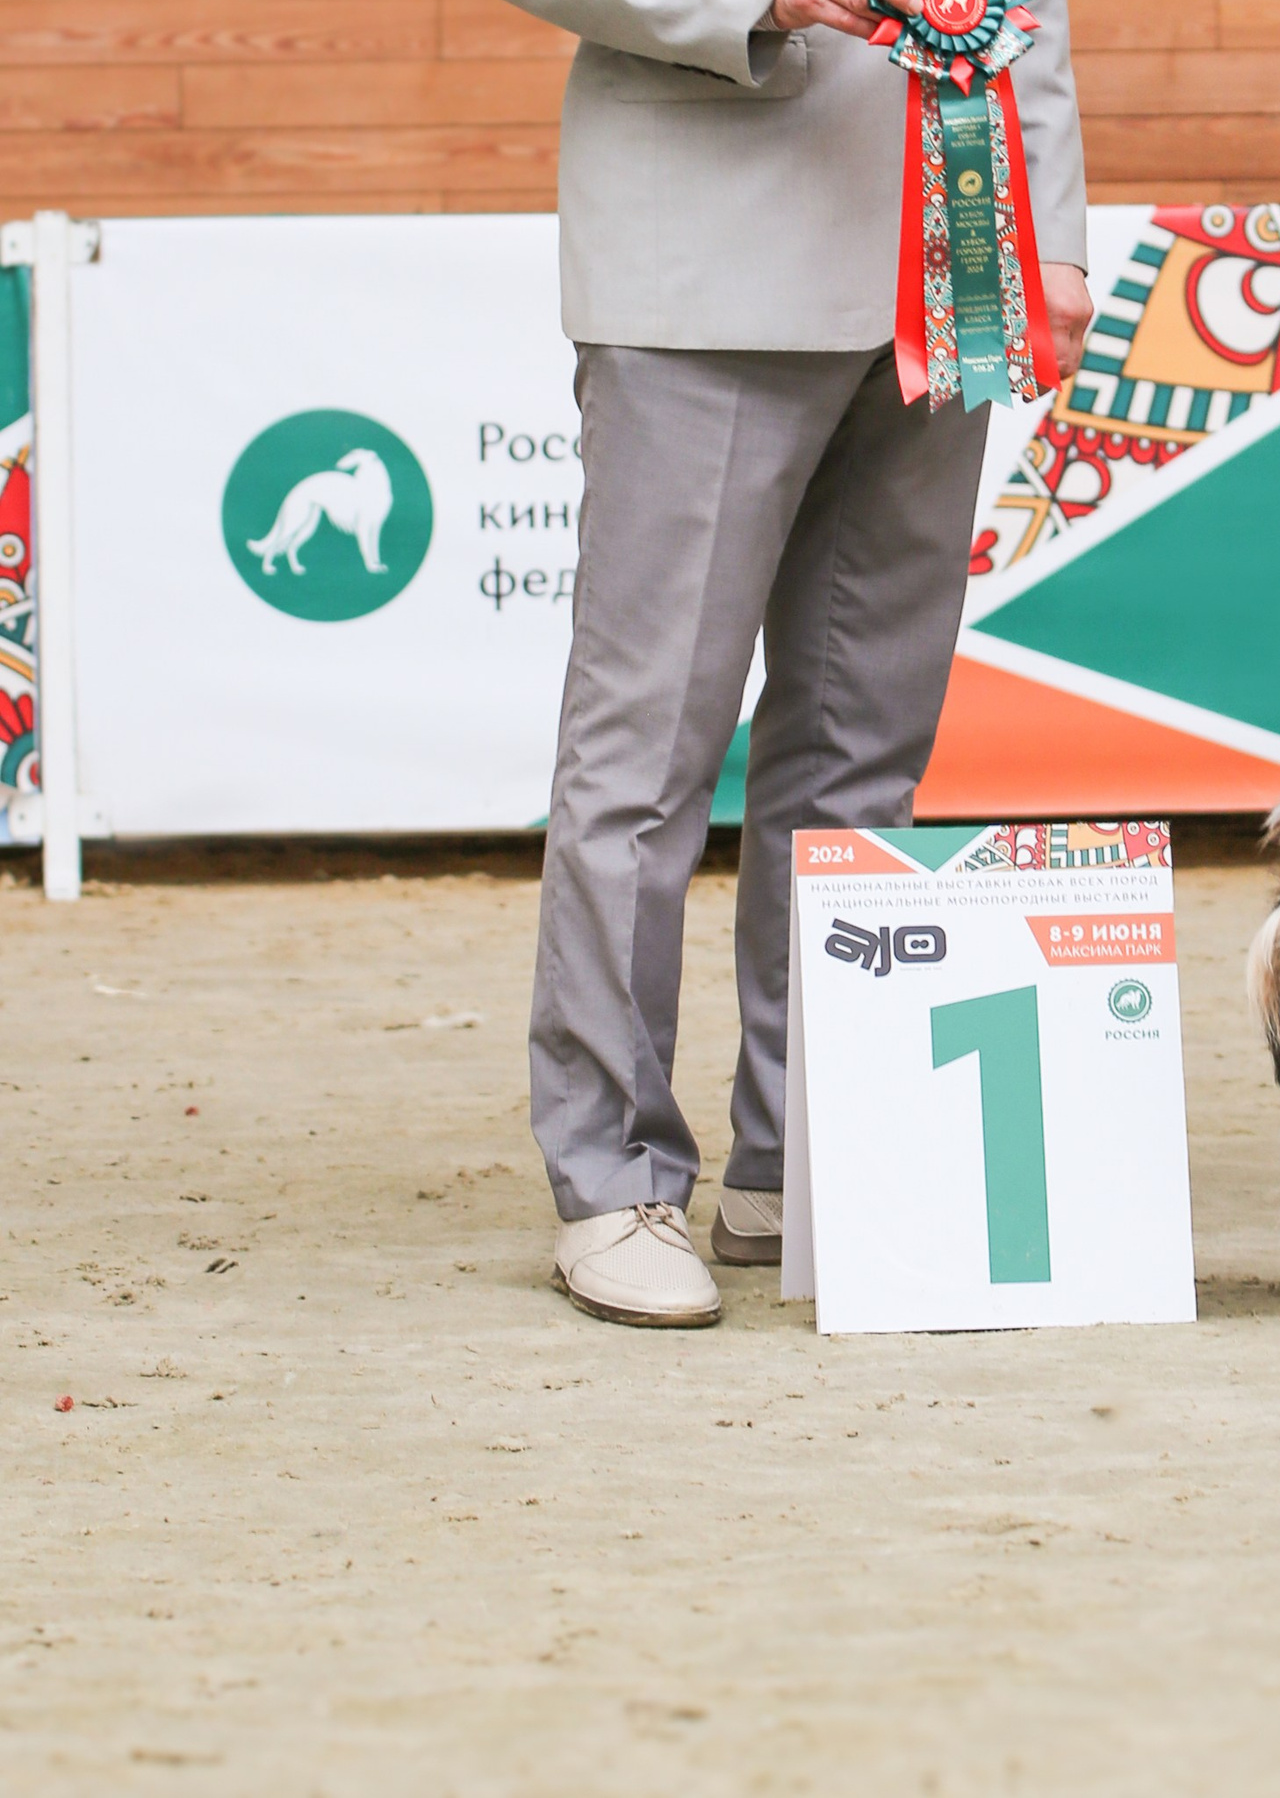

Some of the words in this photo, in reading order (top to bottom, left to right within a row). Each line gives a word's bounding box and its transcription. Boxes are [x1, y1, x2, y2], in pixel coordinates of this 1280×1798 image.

[480, 501, 580, 530] кин
[808, 845, 855, 864] 2024
[811, 880, 931, 894] НАЦИОНАЛЬНЫЕ
[936, 876, 1012, 890] ВЫСТАВКИ
[1017, 876, 1065, 889] СОБАК
[1070, 875, 1104, 887] ВСЕХ
[1110, 874, 1159, 886] ПОРОД
[822, 897, 942, 910] НАЦИОНАЛЬНЫЕ
[947, 893, 1068, 907] МОНОПОРОДНЫЕ
[1074, 891, 1149, 904] ВЫСТАВКИ
[1049, 924, 1085, 943] 8-9
[1091, 922, 1162, 942] ИЮНЯ
[1050, 944, 1123, 958] МАКСИМА
[1125, 943, 1162, 957] ПАРК
[1104, 1029, 1160, 1041] РОССИЯ
[930, 984, 1052, 1284] 1
